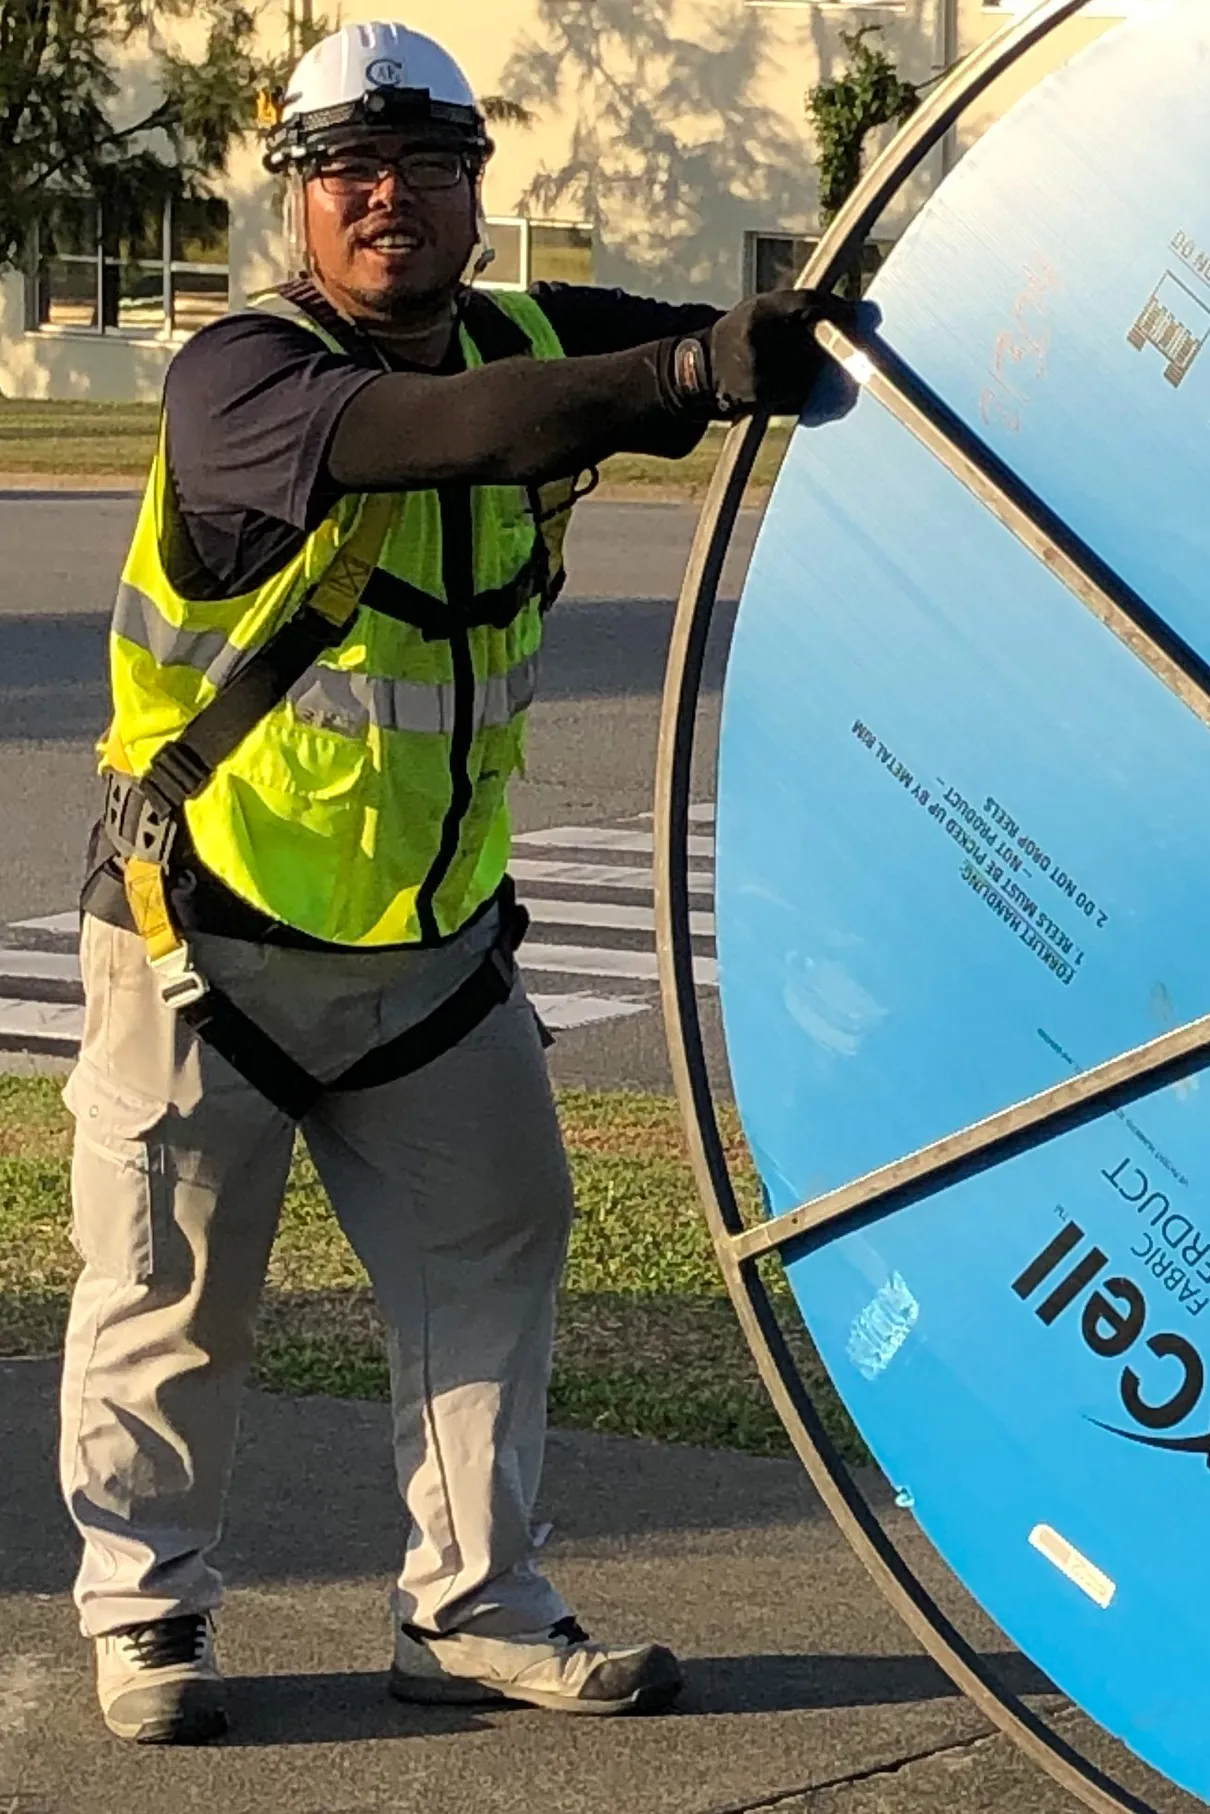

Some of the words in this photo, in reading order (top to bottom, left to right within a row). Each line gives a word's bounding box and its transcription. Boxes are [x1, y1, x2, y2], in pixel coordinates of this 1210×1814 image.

[1170, 230, 1195, 259] DO
[851, 718, 877, 750] RIM
[875, 742, 914, 791] METAL
[911, 784, 930, 806] BY
[927, 802, 947, 825] UP
[942, 786, 998, 846] PRODUCT
[983, 796, 1020, 837] REELS
[945, 818, 988, 865] PICKED
[996, 841, 1024, 873] NOT
[1017, 835, 1052, 871] DROP
[985, 860, 1003, 882] BE
[1050, 866, 1078, 898] NOT
[1000, 874, 1039, 918] MUST
[1075, 892, 1096, 918] DO
[1035, 912, 1074, 955] REELS
[1020, 923, 1077, 986] FORKLIFT
[1130, 1232, 1210, 1317] FABRIC
